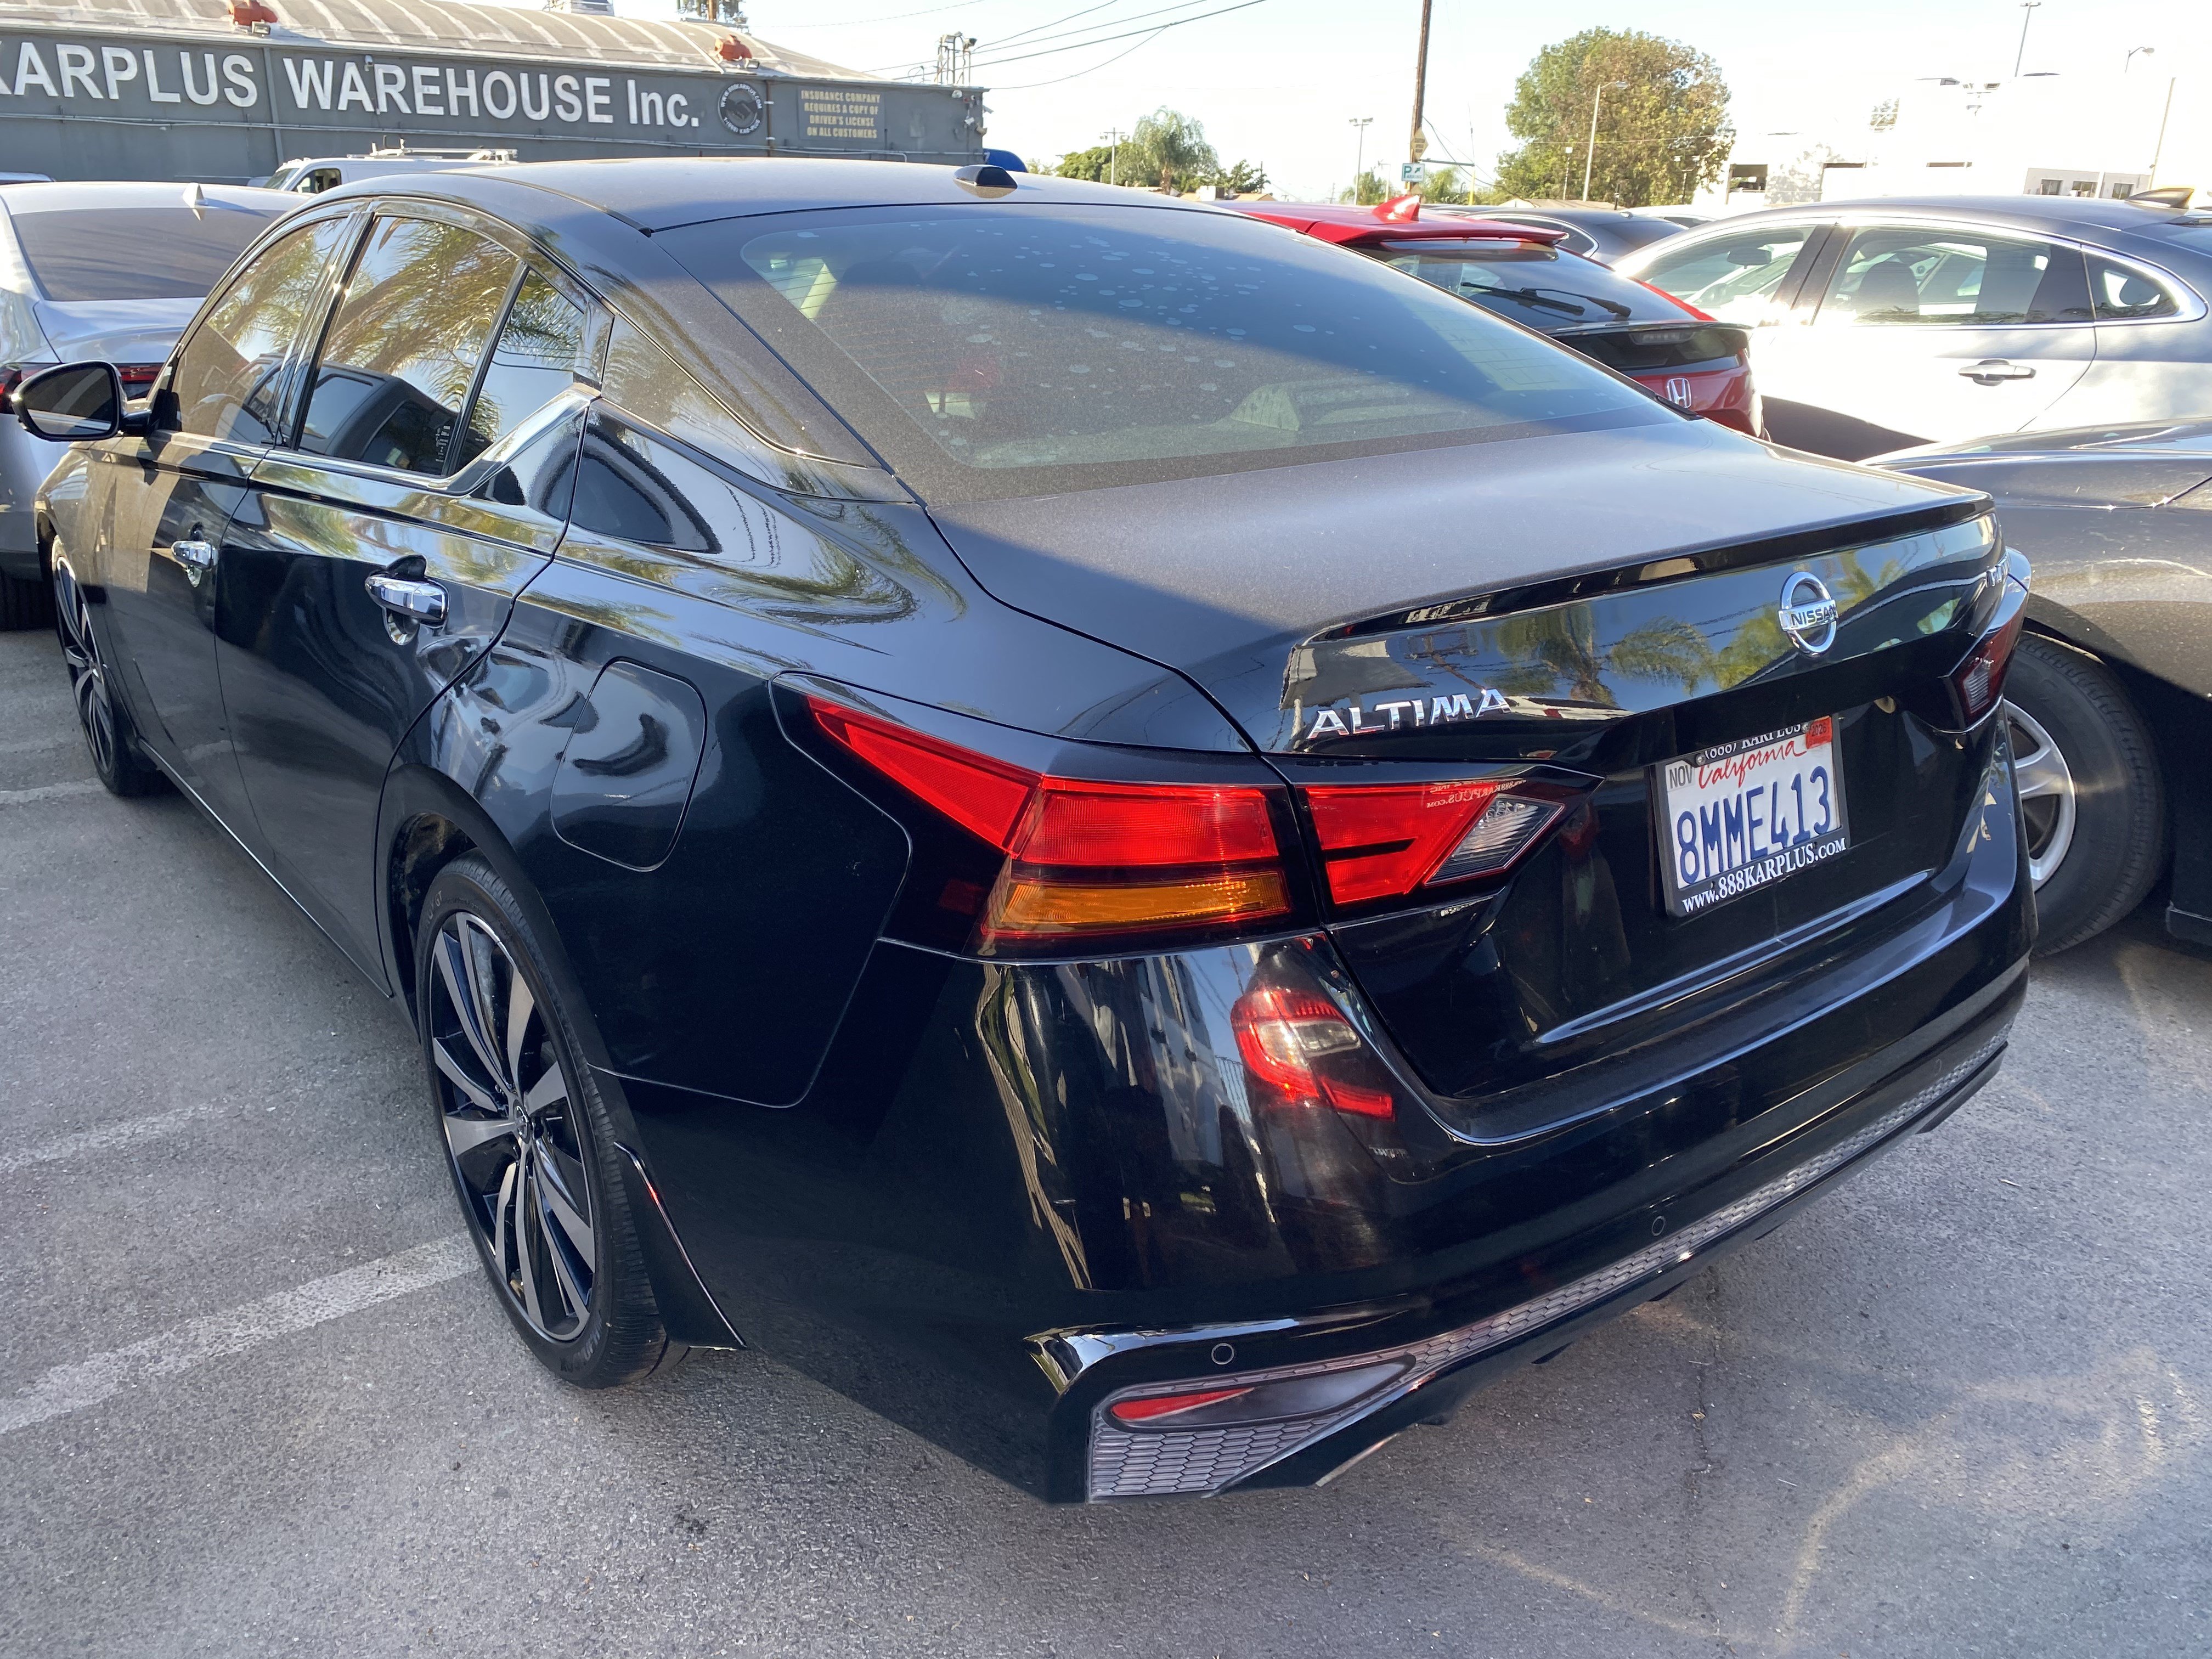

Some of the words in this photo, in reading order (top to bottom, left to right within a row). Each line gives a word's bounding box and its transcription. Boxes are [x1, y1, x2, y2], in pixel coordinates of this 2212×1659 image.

[283, 58, 613, 123] WAREHOUSE
[627, 79, 699, 127] Inc.
[801, 90, 844, 101] INSURANCE
[845, 92, 880, 103] COMPANY
[804, 103, 840, 113] REQUIRES
[842, 104, 847, 114] A
[849, 105, 868, 114] COPY
[870, 106, 878, 115] OF
[810, 115, 843, 125] DRIVER'S
[845, 117, 874, 126] LICENSE
[807, 127, 817, 136] ON
[819, 127, 831, 137] ALL
[833, 128, 877, 138] CUSTOMERS
[1790, 603, 1836, 627] NISSAN
[1307, 689, 1513, 739] ALTIMA
[1699, 740, 1807, 789] California
[1669, 765, 1693, 789] NOV
[1677, 766, 1830, 884] 8MME413
